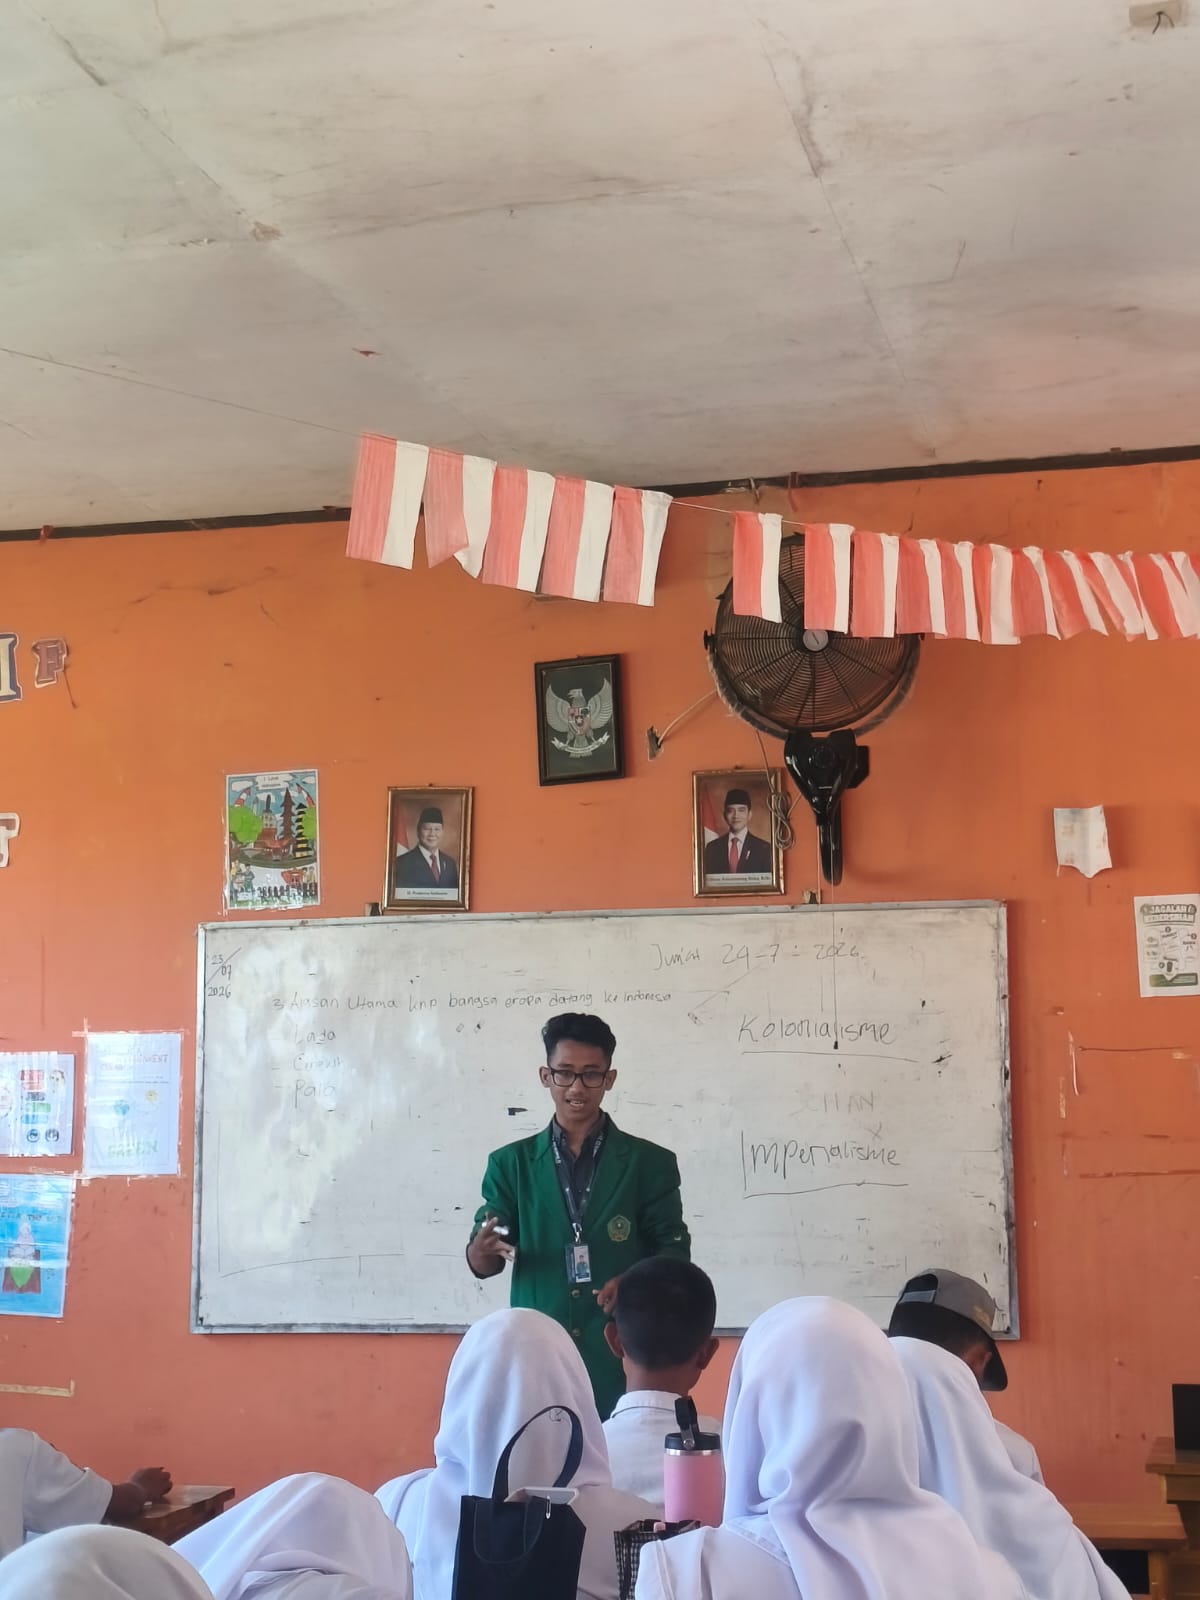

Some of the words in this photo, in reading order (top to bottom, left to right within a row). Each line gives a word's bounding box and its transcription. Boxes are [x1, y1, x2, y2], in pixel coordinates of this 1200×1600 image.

[347, 995, 400, 1010] Utama
[448, 991, 498, 1009] bangsa
[504, 994, 542, 1008] eropa
[548, 992, 593, 1007] datang
[738, 1014, 897, 1045] Kolonialisme
